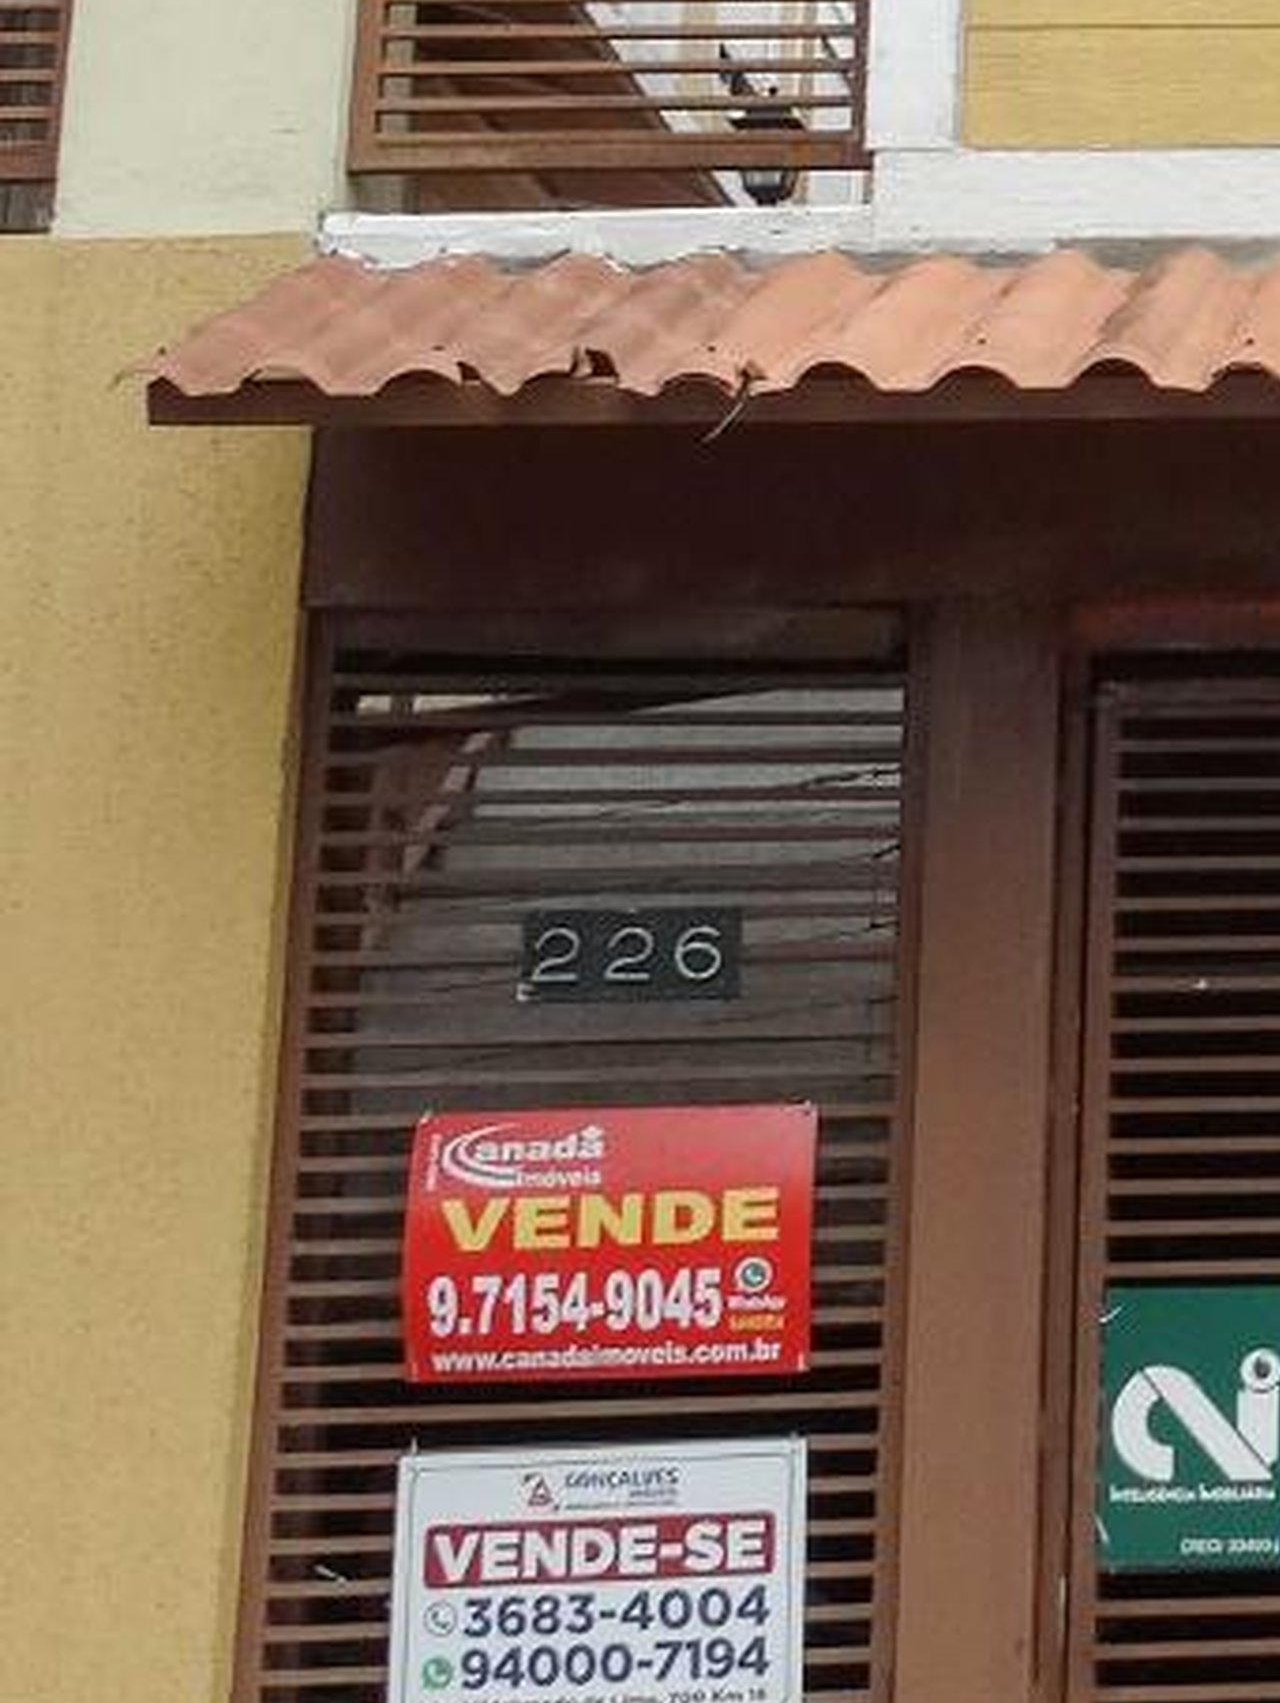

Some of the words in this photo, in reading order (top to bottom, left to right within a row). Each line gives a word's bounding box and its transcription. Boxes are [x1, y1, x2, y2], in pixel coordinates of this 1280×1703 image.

[531, 926, 723, 983] 226
[441, 1187, 780, 1253] VENDE
[427, 1267, 721, 1337] 9.7154-9045
[431, 1337, 782, 1373] www.canadaimoveis.com.br
[432, 1517, 767, 1583] VENDE-SE
[463, 1585, 771, 1638] 3683-4004
[460, 1636, 770, 1690] 94000-7194
